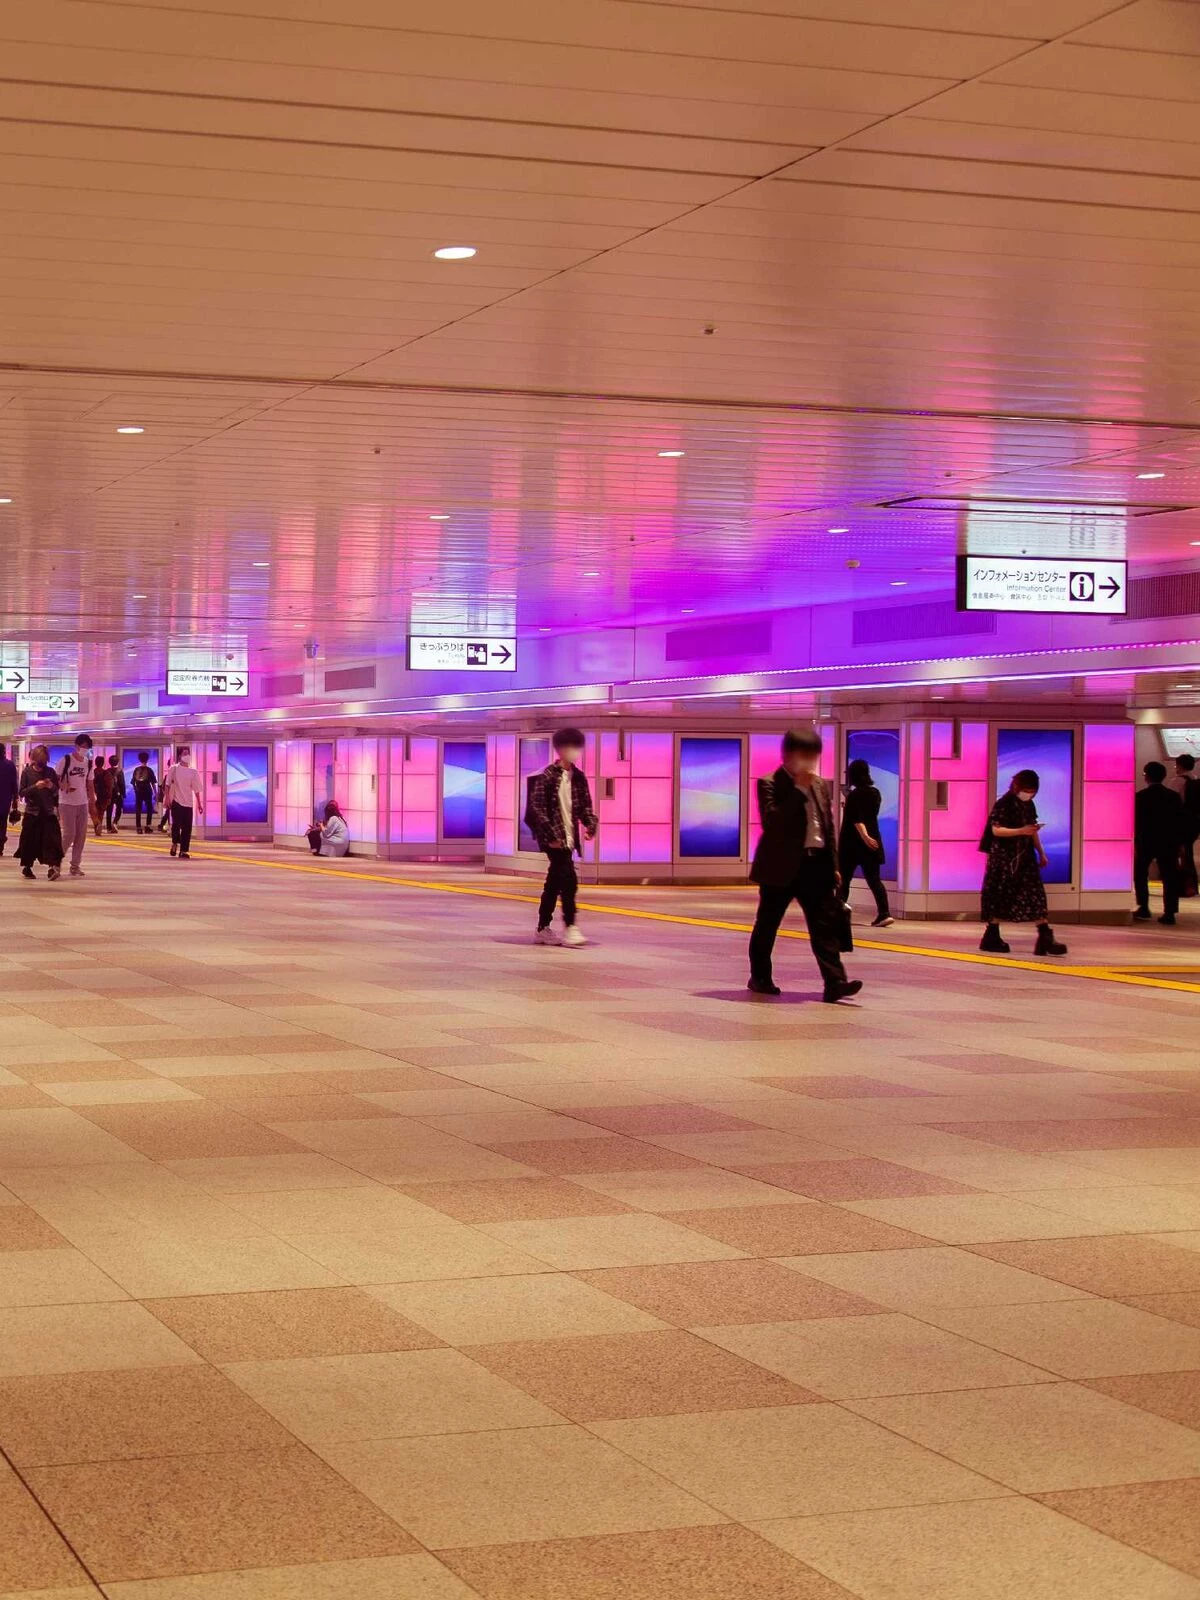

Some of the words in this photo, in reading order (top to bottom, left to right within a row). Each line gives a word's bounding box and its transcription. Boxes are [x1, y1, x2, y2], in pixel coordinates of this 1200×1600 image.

[973, 569, 1066, 583] インフォメーションセンター
[1006, 584, 1043, 592] Information
[1044, 585, 1066, 593] Center
